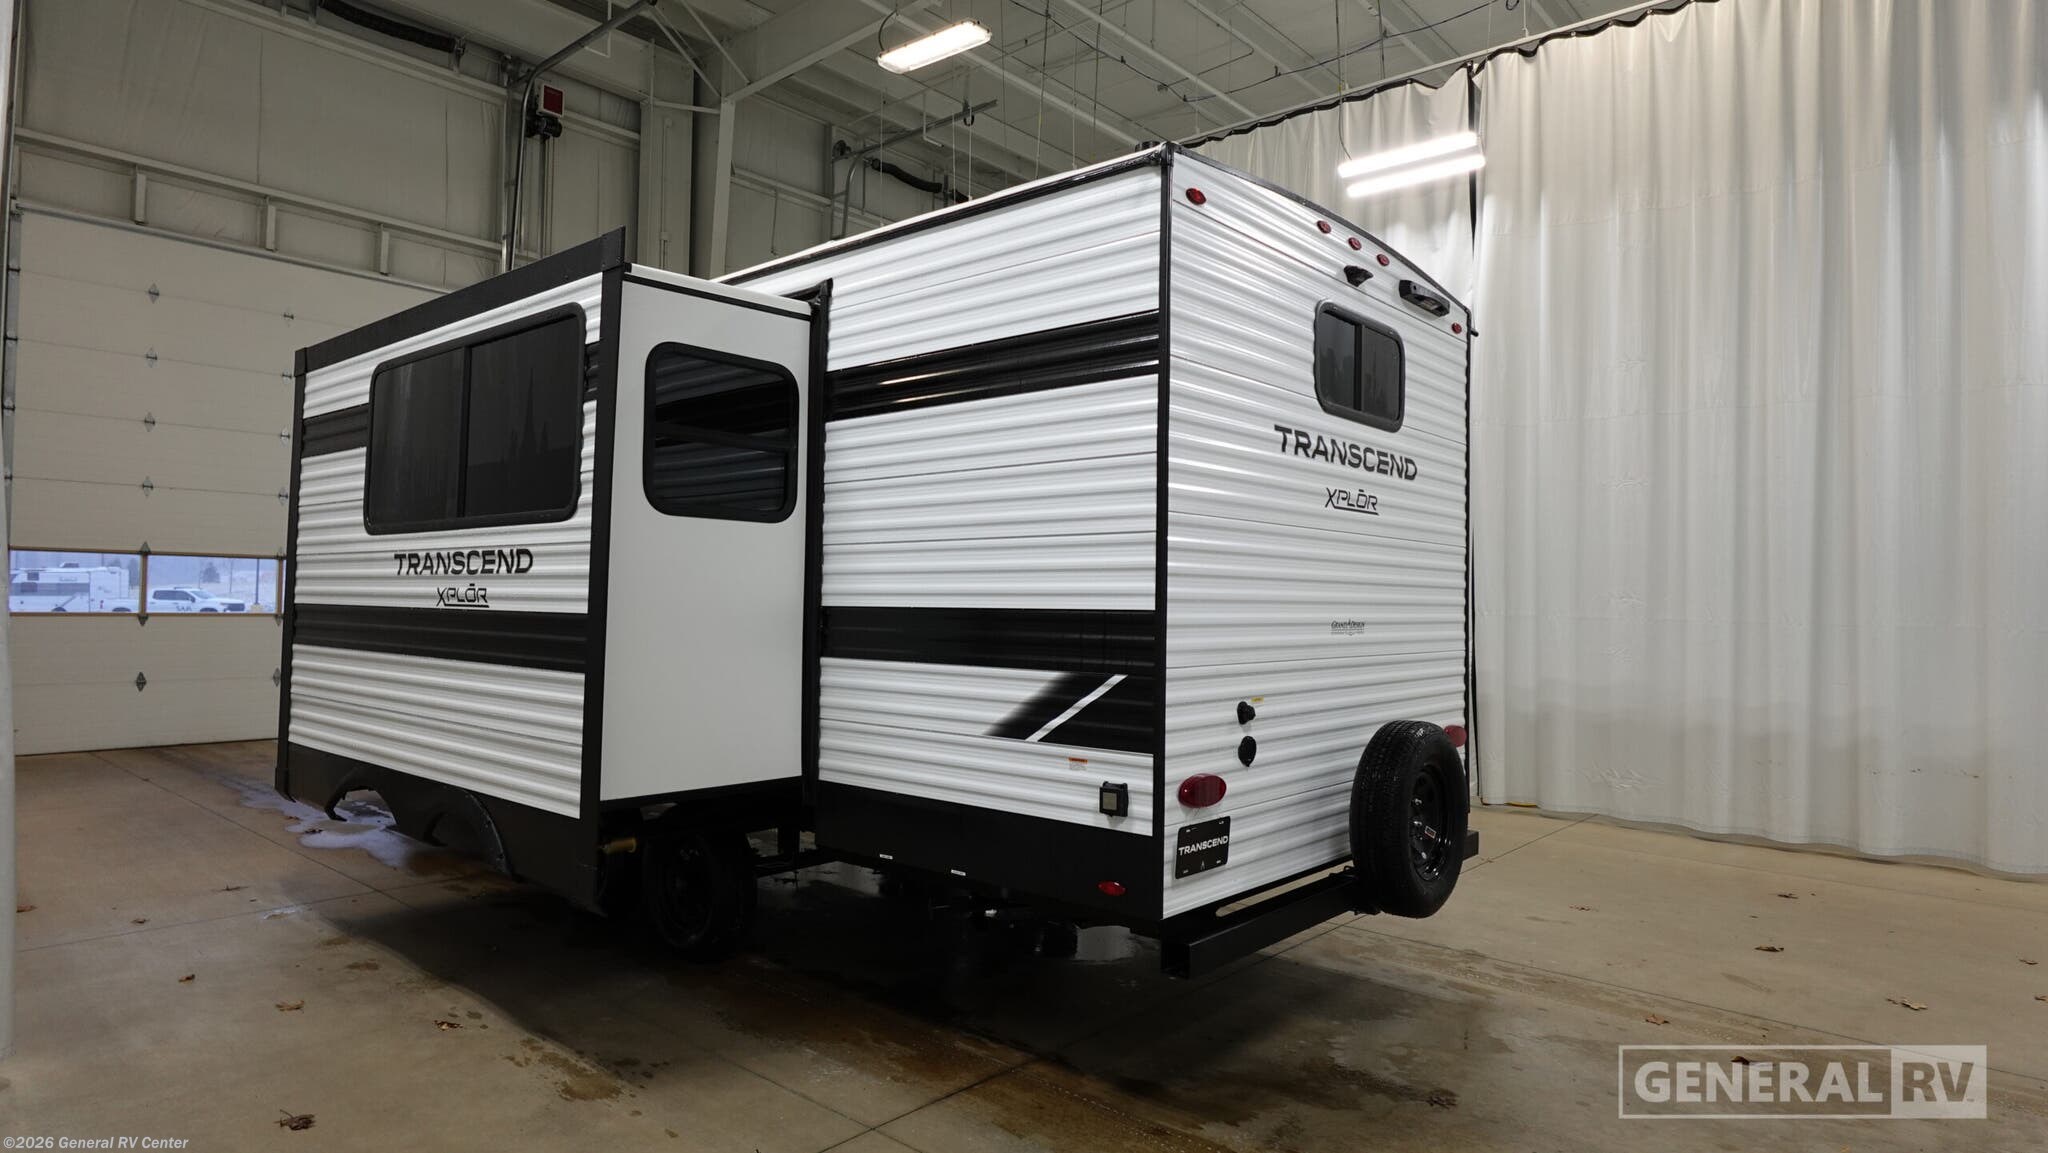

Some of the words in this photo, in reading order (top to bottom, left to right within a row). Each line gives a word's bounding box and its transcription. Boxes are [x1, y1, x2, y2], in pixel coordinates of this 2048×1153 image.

[1274, 424, 1418, 481] TRANSCEND
[394, 548, 534, 576] TRANSCEND
[1178, 835, 1229, 856] TRANSCEND
